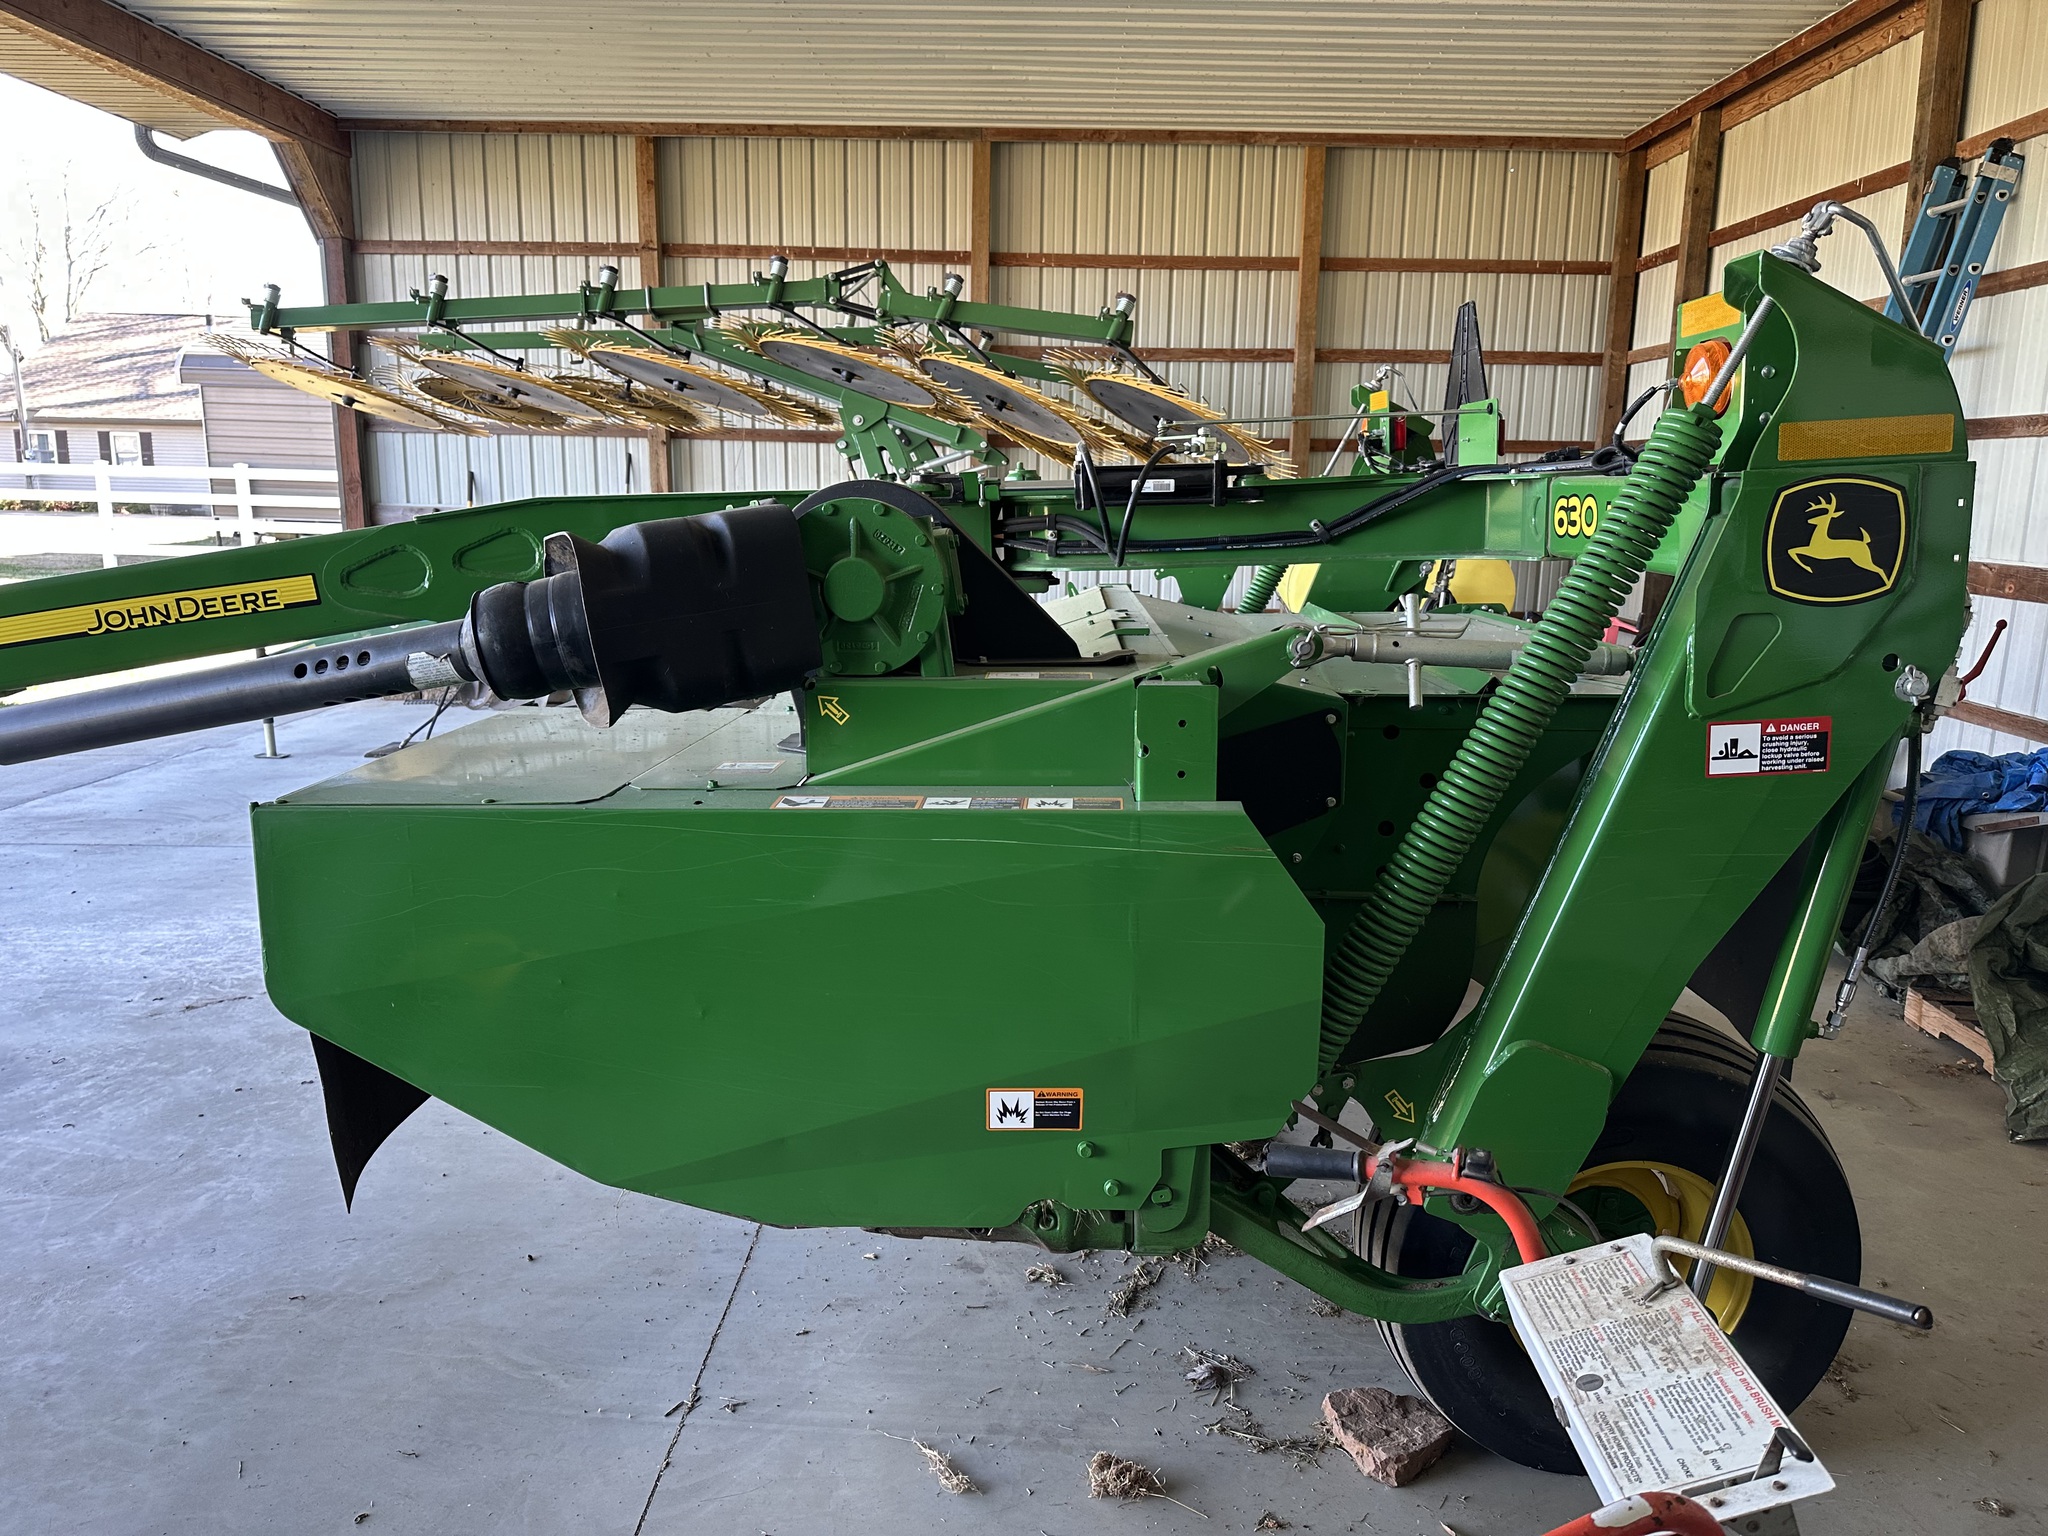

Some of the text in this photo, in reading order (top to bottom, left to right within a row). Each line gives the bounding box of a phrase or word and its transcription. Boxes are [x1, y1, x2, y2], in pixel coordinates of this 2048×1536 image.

[1954, 290, 1968, 321] WERNER
[1554, 494, 1598, 539] 630
[87, 589, 281, 632] JOHN DEERE
[1780, 723, 1819, 731] DANGER
[1715, 1375, 1734, 1394] ENGAGE
[1728, 1394, 1745, 1410] WHEEL
[1721, 1355, 1746, 1377] FIELD
[1737, 1377, 1755, 1391] and
[1747, 1391, 1777, 1419] BRUSH
[1597, 1410, 1615, 1435] COUNTRY
[1610, 1435, 1624, 1451] HOME
[1675, 1457, 1694, 1478] CHOKE
[1708, 1457, 1723, 1471] RUN
